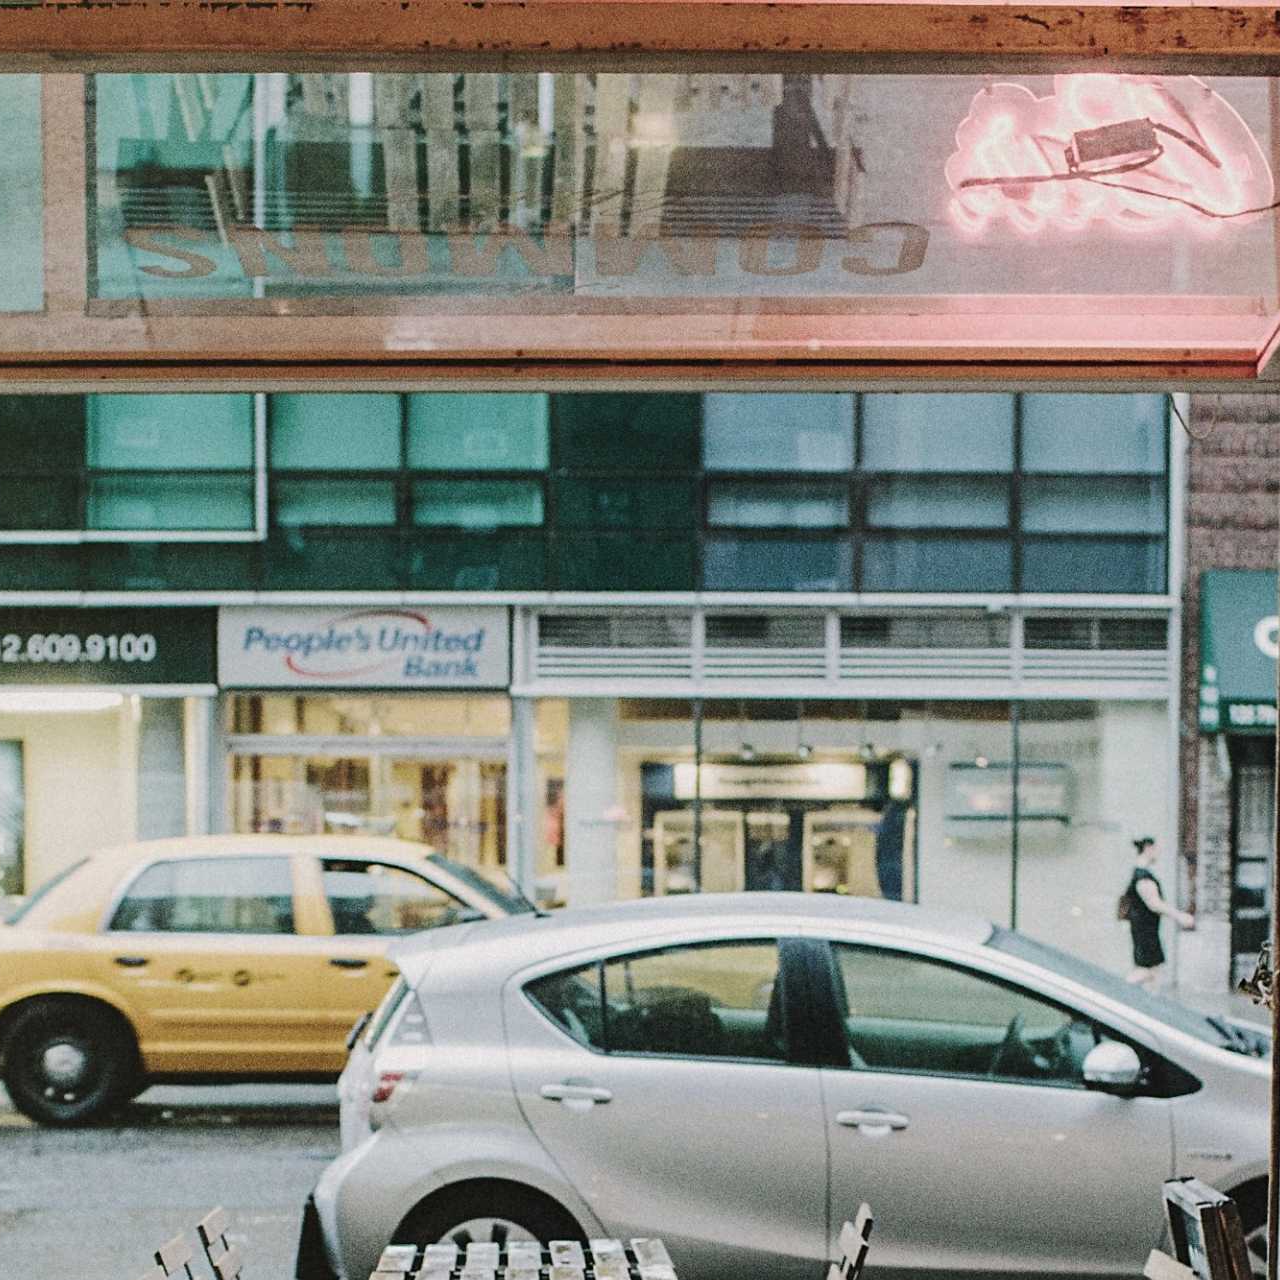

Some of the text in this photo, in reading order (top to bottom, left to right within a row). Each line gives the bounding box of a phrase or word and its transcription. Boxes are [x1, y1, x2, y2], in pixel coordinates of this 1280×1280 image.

[243, 625, 486, 657] People's United
[403, 656, 480, 678] Bank
